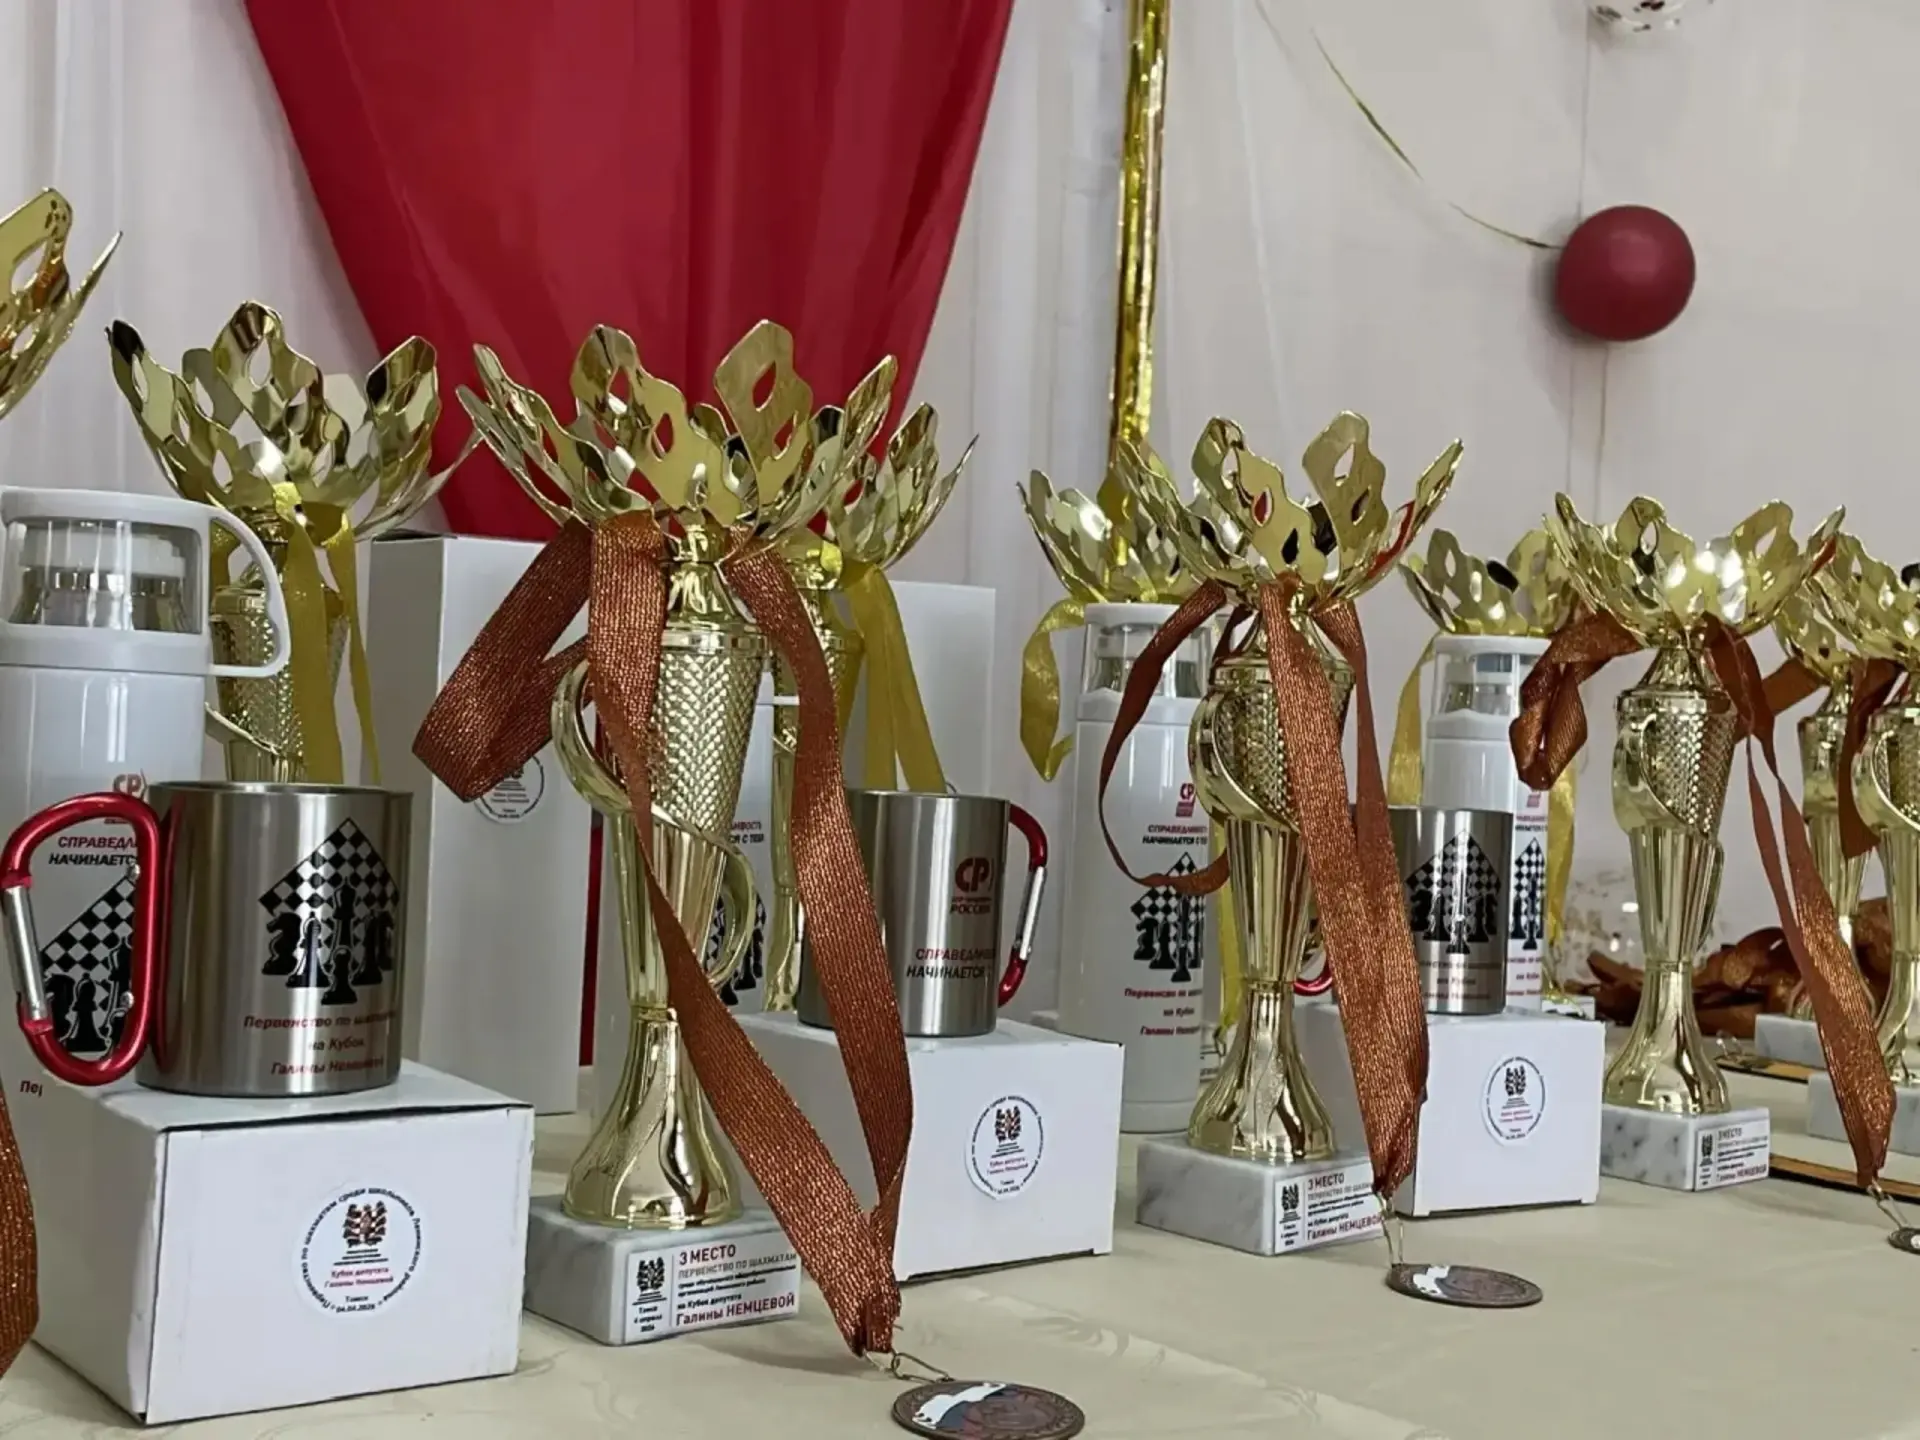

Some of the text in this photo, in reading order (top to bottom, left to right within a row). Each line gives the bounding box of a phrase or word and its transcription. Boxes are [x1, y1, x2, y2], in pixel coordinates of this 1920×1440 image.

[58, 836, 138, 850] СПРАВЕДЛ
[48, 852, 137, 866] НАЧИНАЕТС
[955, 857, 990, 892] СР
[690, 1244, 736, 1263] МЕСТО
[676, 1292, 795, 1326] Галины НЕМЦЕВОЙ
